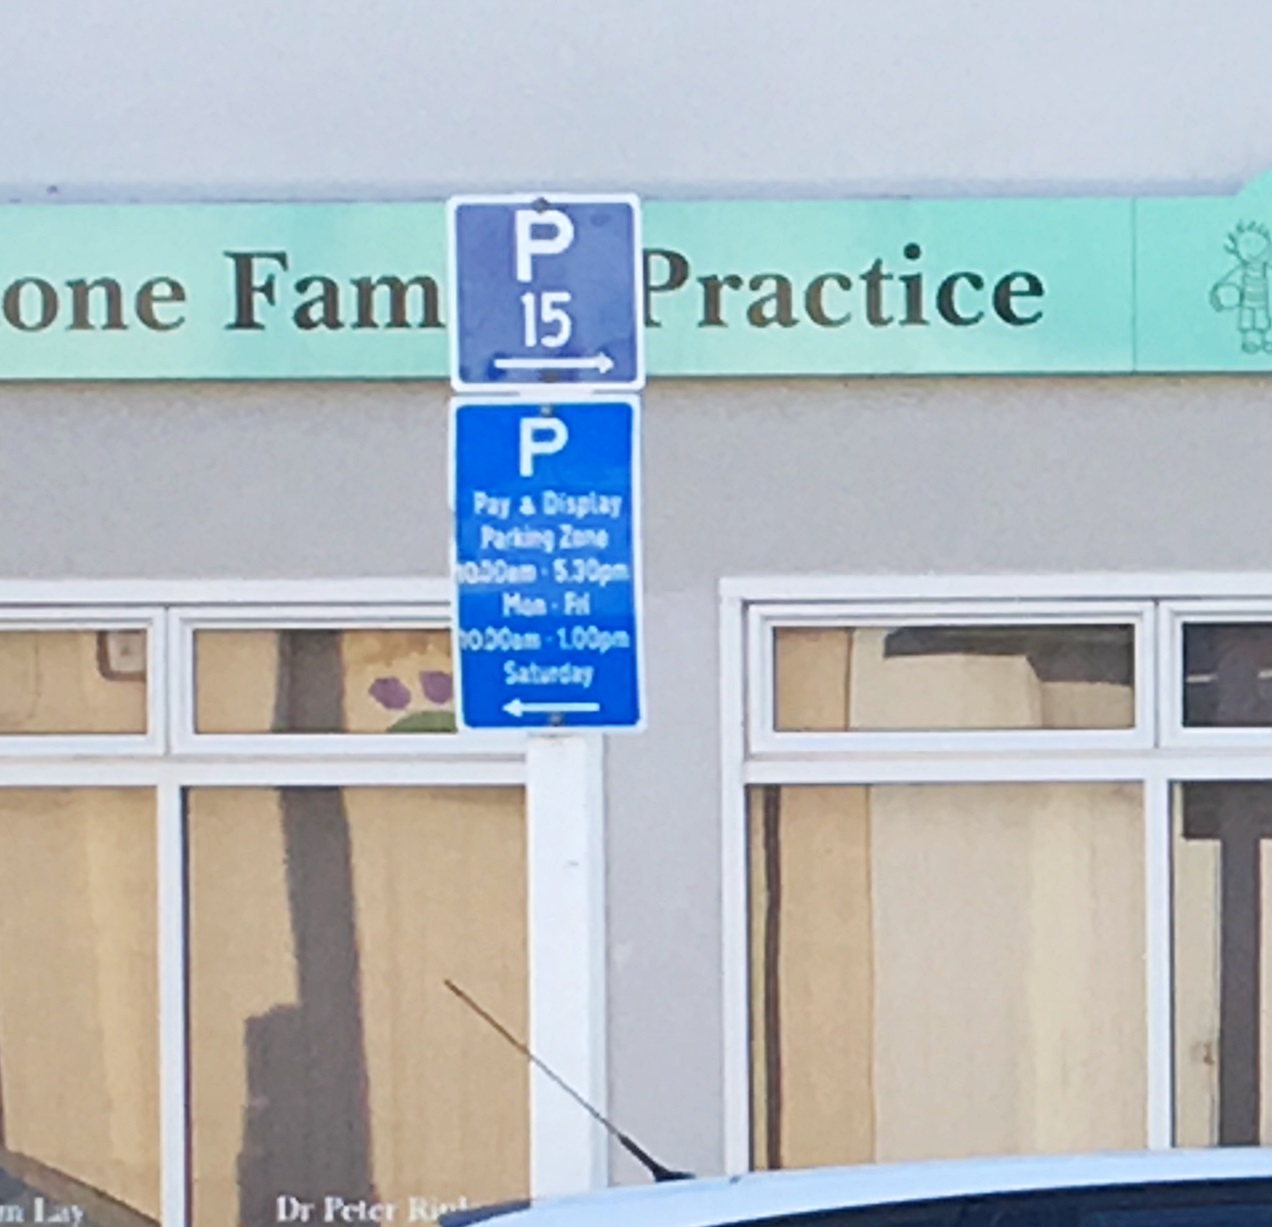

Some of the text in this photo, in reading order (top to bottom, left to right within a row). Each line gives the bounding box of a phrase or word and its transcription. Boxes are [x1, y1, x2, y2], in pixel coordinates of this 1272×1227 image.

[515, 208, 575, 283] P
[223, 252, 446, 331] Fam
[643, 243, 1045, 328] Practice
[521, 291, 572, 348] 15
[519, 417, 569, 477] P
[474, 491, 511, 520] Pay
[542, 490, 623, 519] Display
[481, 524, 609, 554] Parking Zone
[503, 592, 547, 617] Mon
[564, 591, 590, 616] Fri
[504, 660, 594, 688] Saturday
[276, 1196, 314, 1222] Dr
[324, 1196, 399, 1222] Peter
